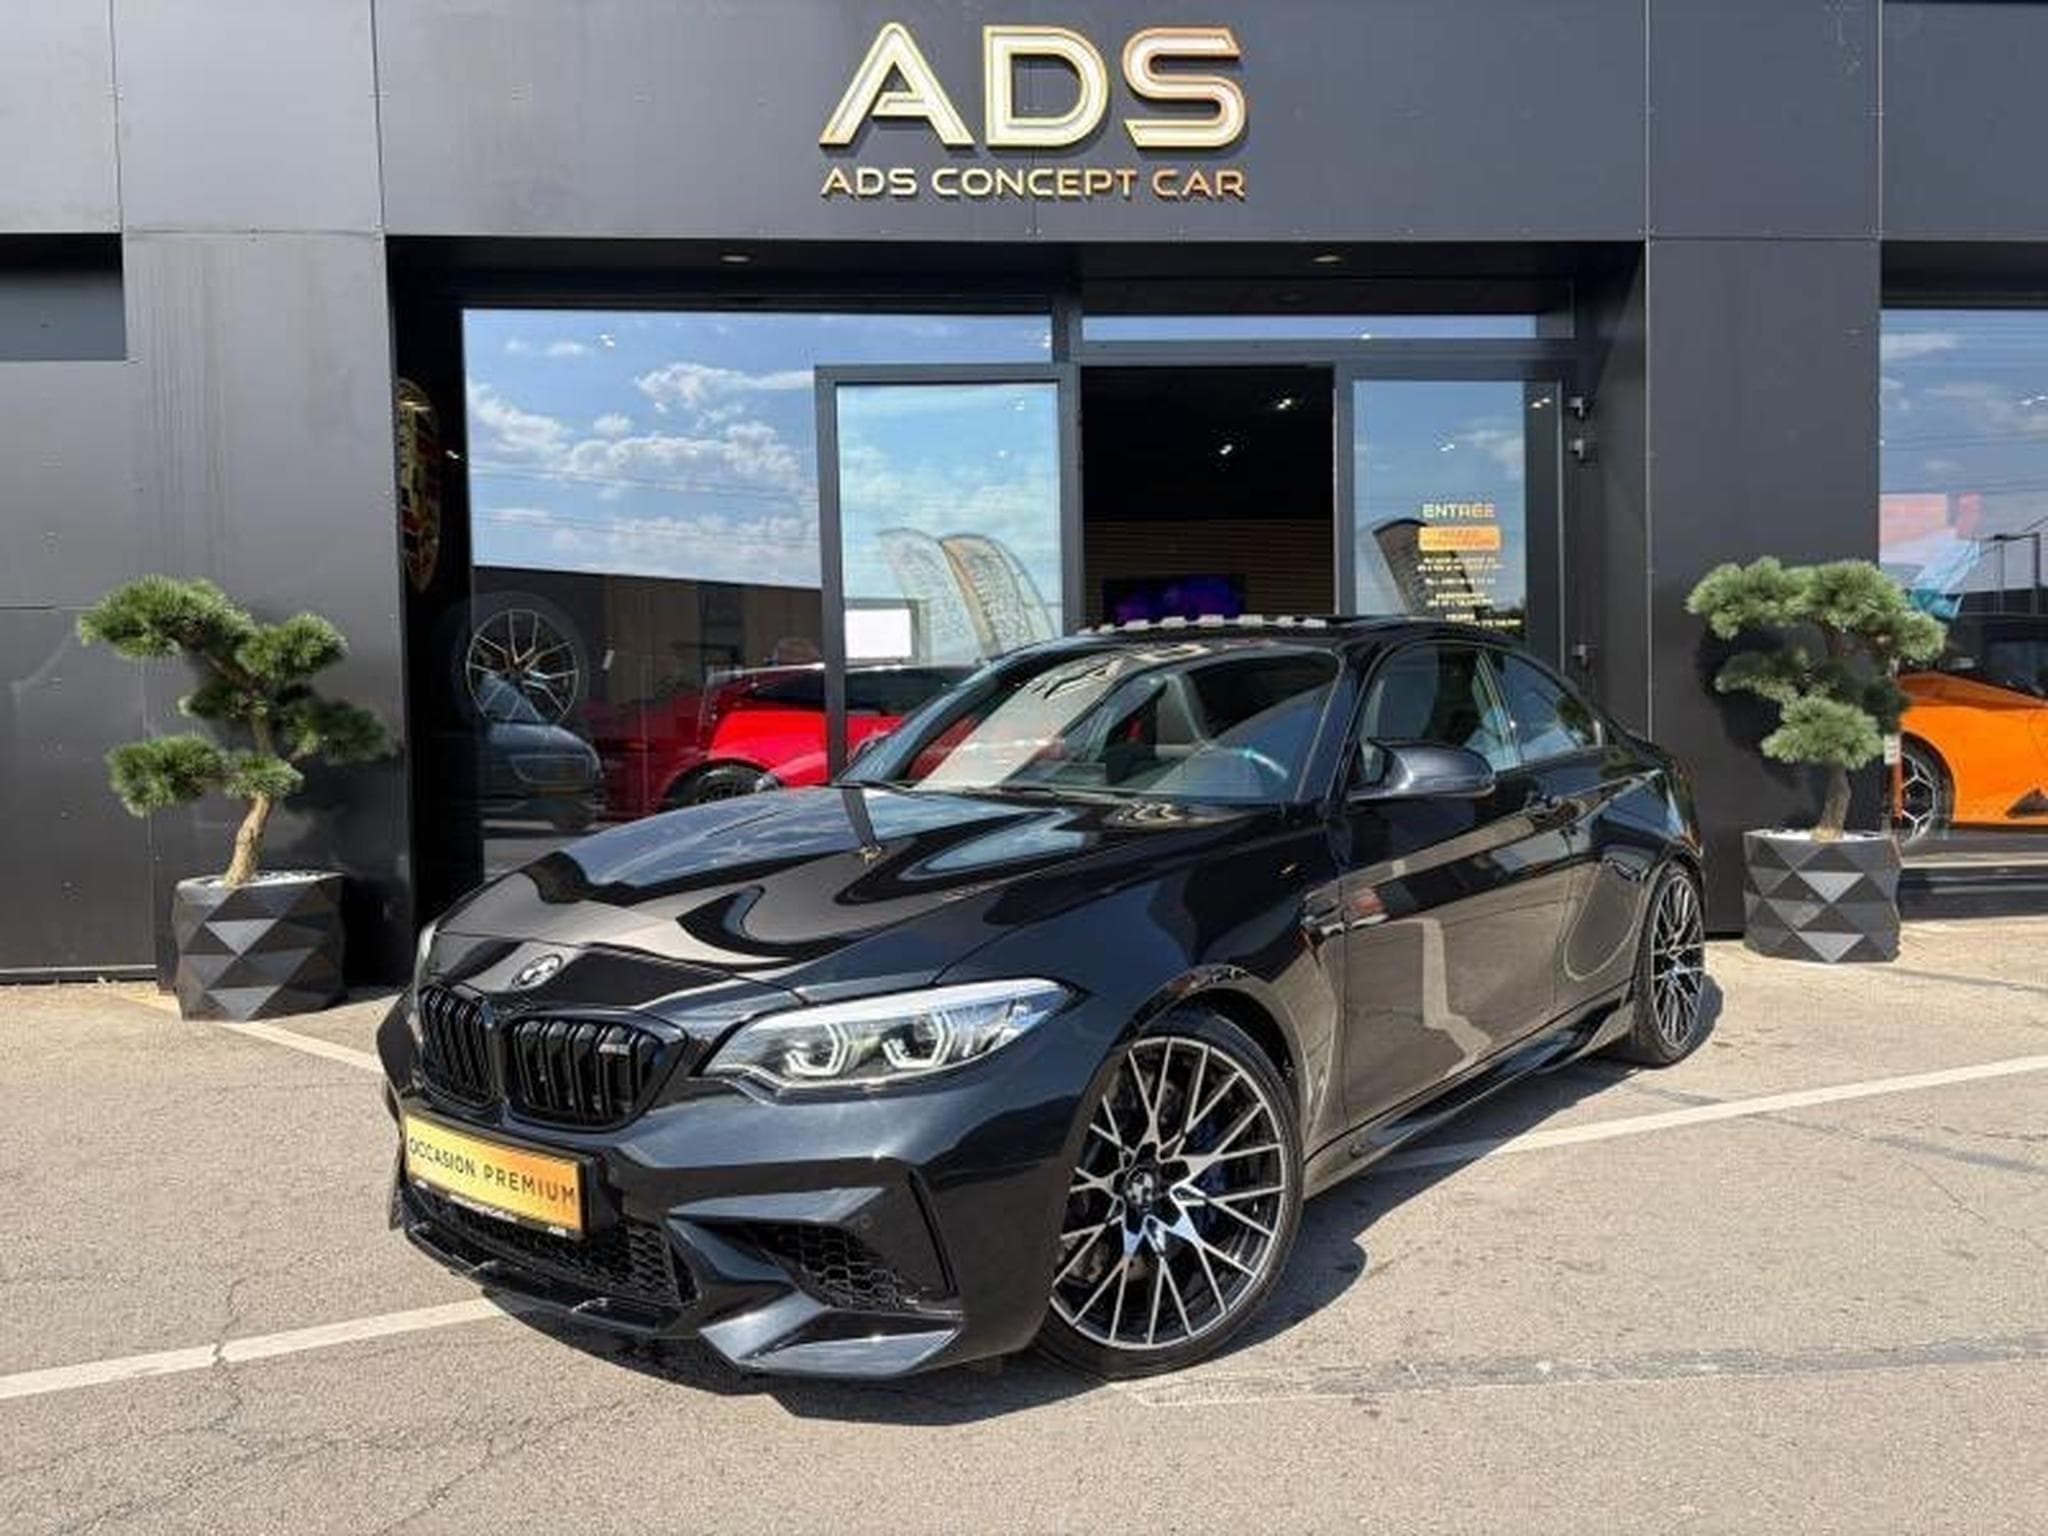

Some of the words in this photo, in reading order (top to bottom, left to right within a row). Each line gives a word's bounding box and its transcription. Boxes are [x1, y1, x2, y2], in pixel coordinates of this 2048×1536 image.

[818, 21, 1247, 148] ADS
[820, 167, 917, 197] ADS
[931, 167, 1138, 198] CONCEPT
[1151, 168, 1246, 198] CAR
[409, 1137, 477, 1178] OCCASION
[483, 1163, 576, 1205] PREMIUM
